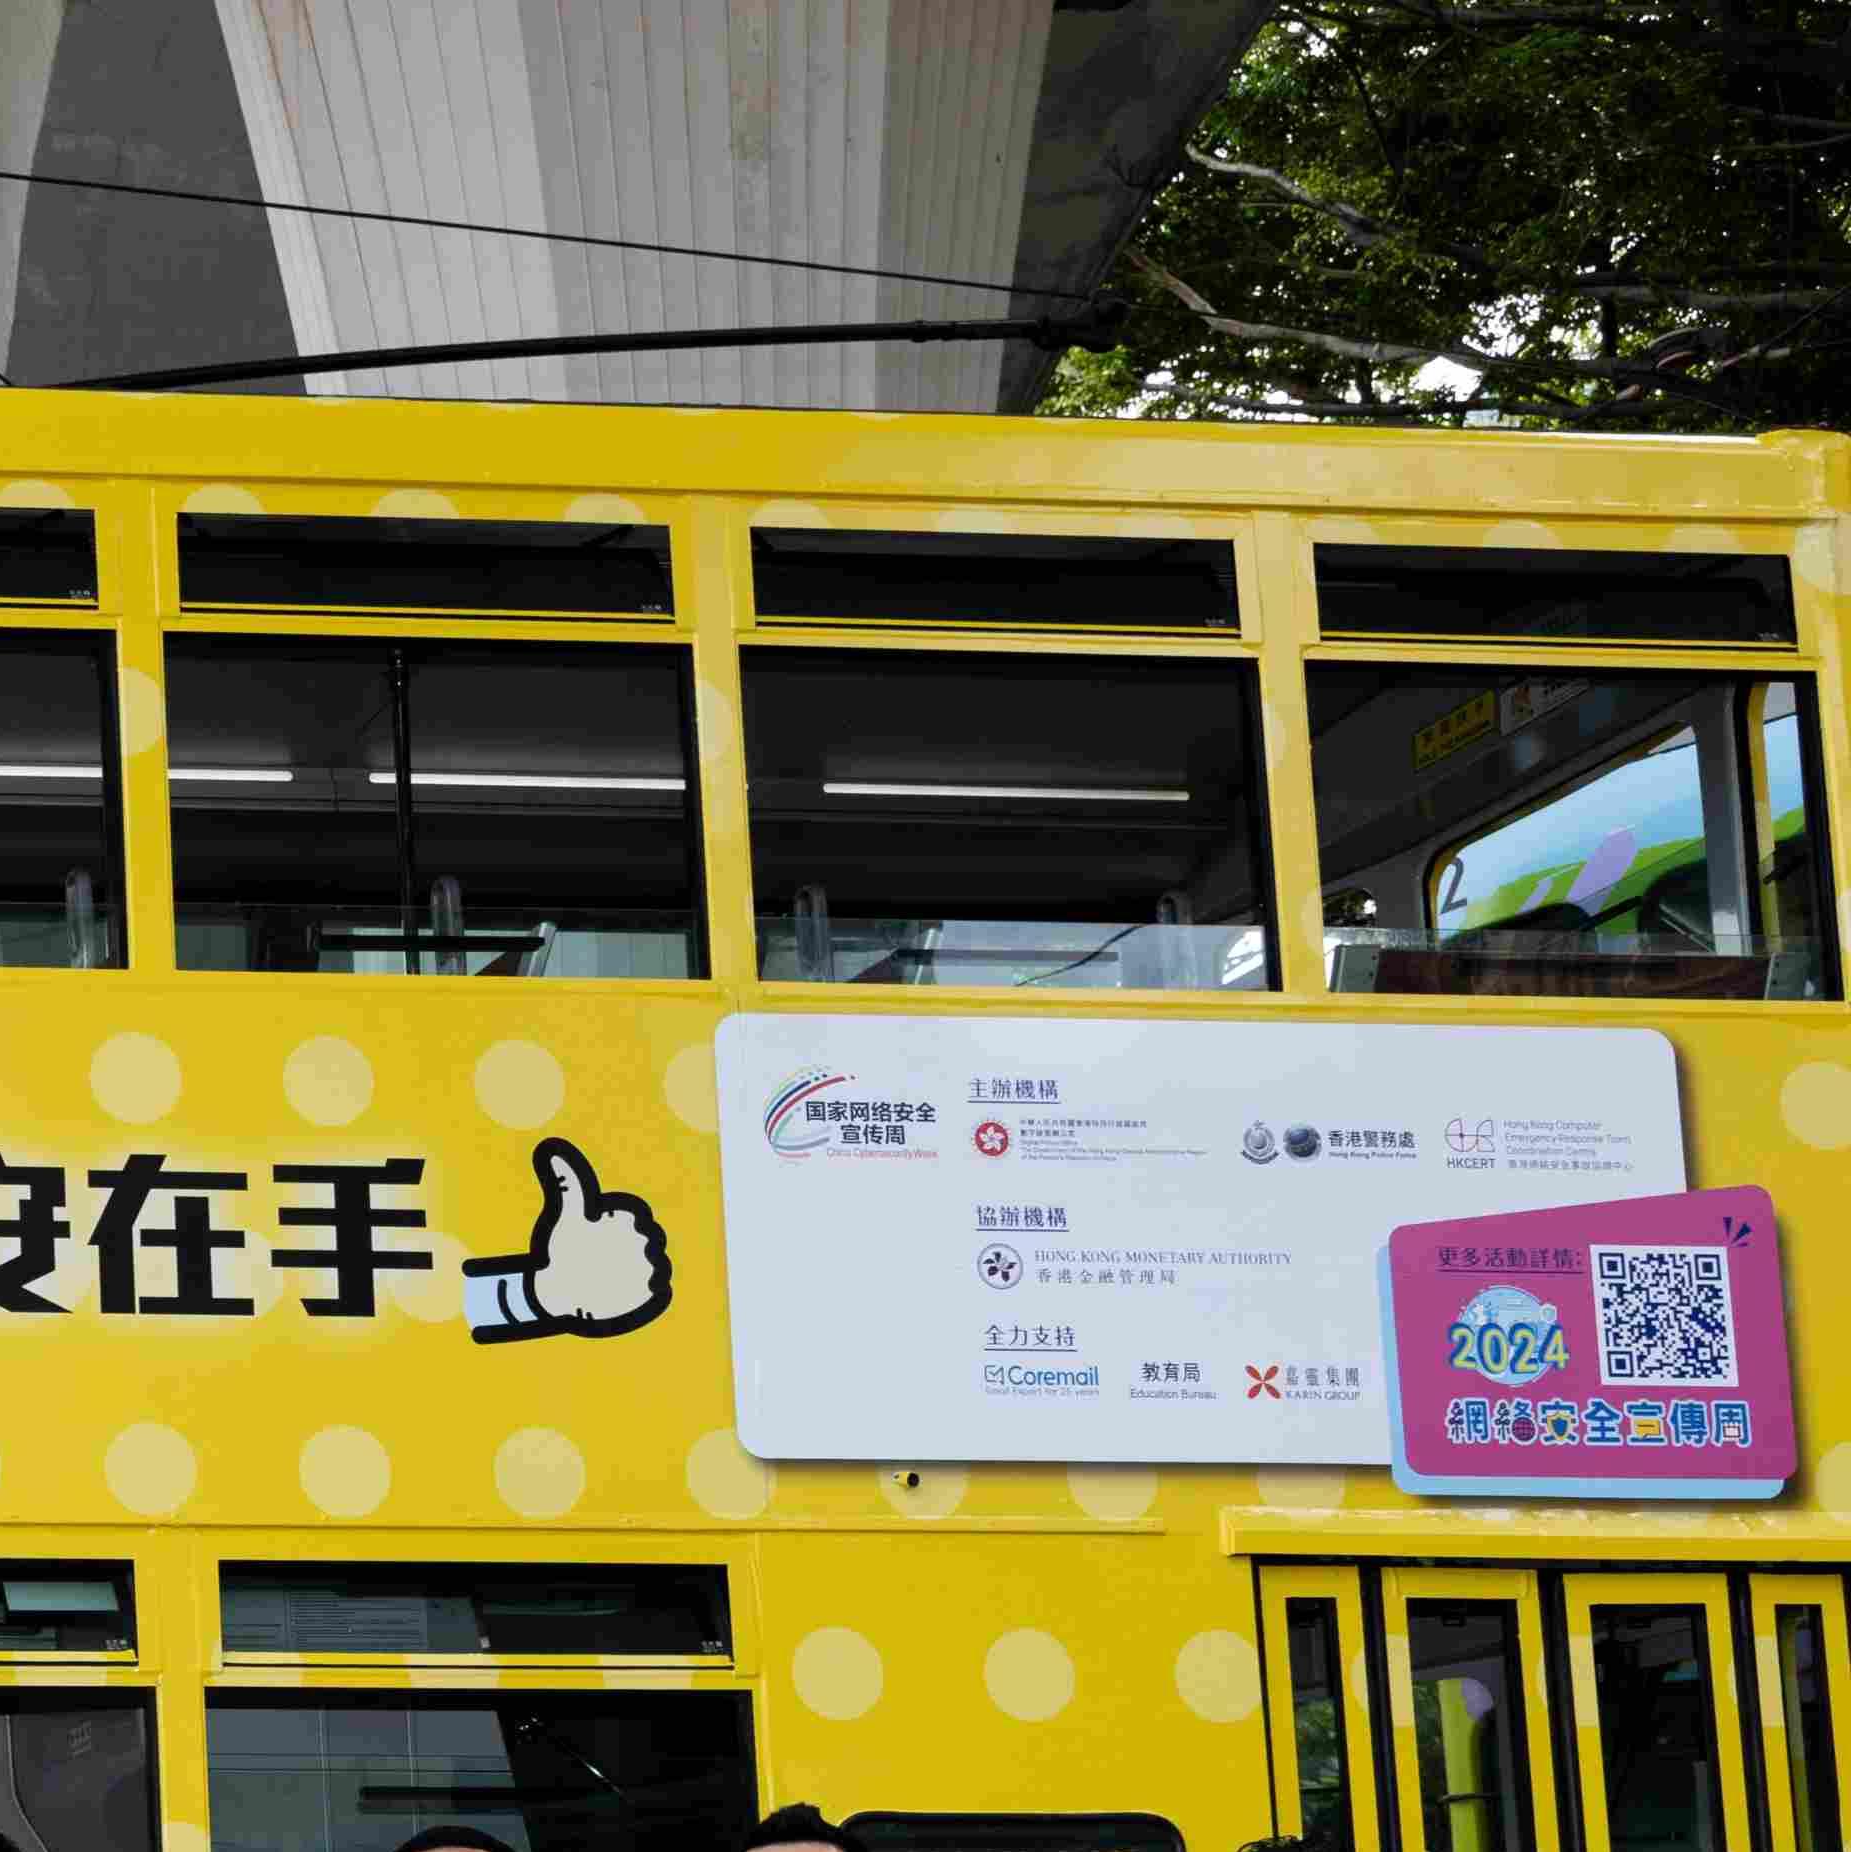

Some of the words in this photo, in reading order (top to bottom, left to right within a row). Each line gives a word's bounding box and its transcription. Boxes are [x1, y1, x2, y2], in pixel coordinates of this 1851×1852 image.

[969, 1078, 1059, 1100] 主辦機構
[805, 1101, 936, 1124] 国家网络安全
[839, 1124, 906, 1145] 宣传周
[1447, 1157, 1496, 1169] HKCERT
[975, 1205, 1068, 1228] 協辦機構
[984, 1324, 1076, 1347] 全力支持
[1448, 1322, 1569, 1374] 2024
[1008, 1365, 1099, 1386] Coremail
[1140, 1362, 1201, 1383] 教育局
[1446, 1398, 1752, 1448] 網絡安全宣傳周
